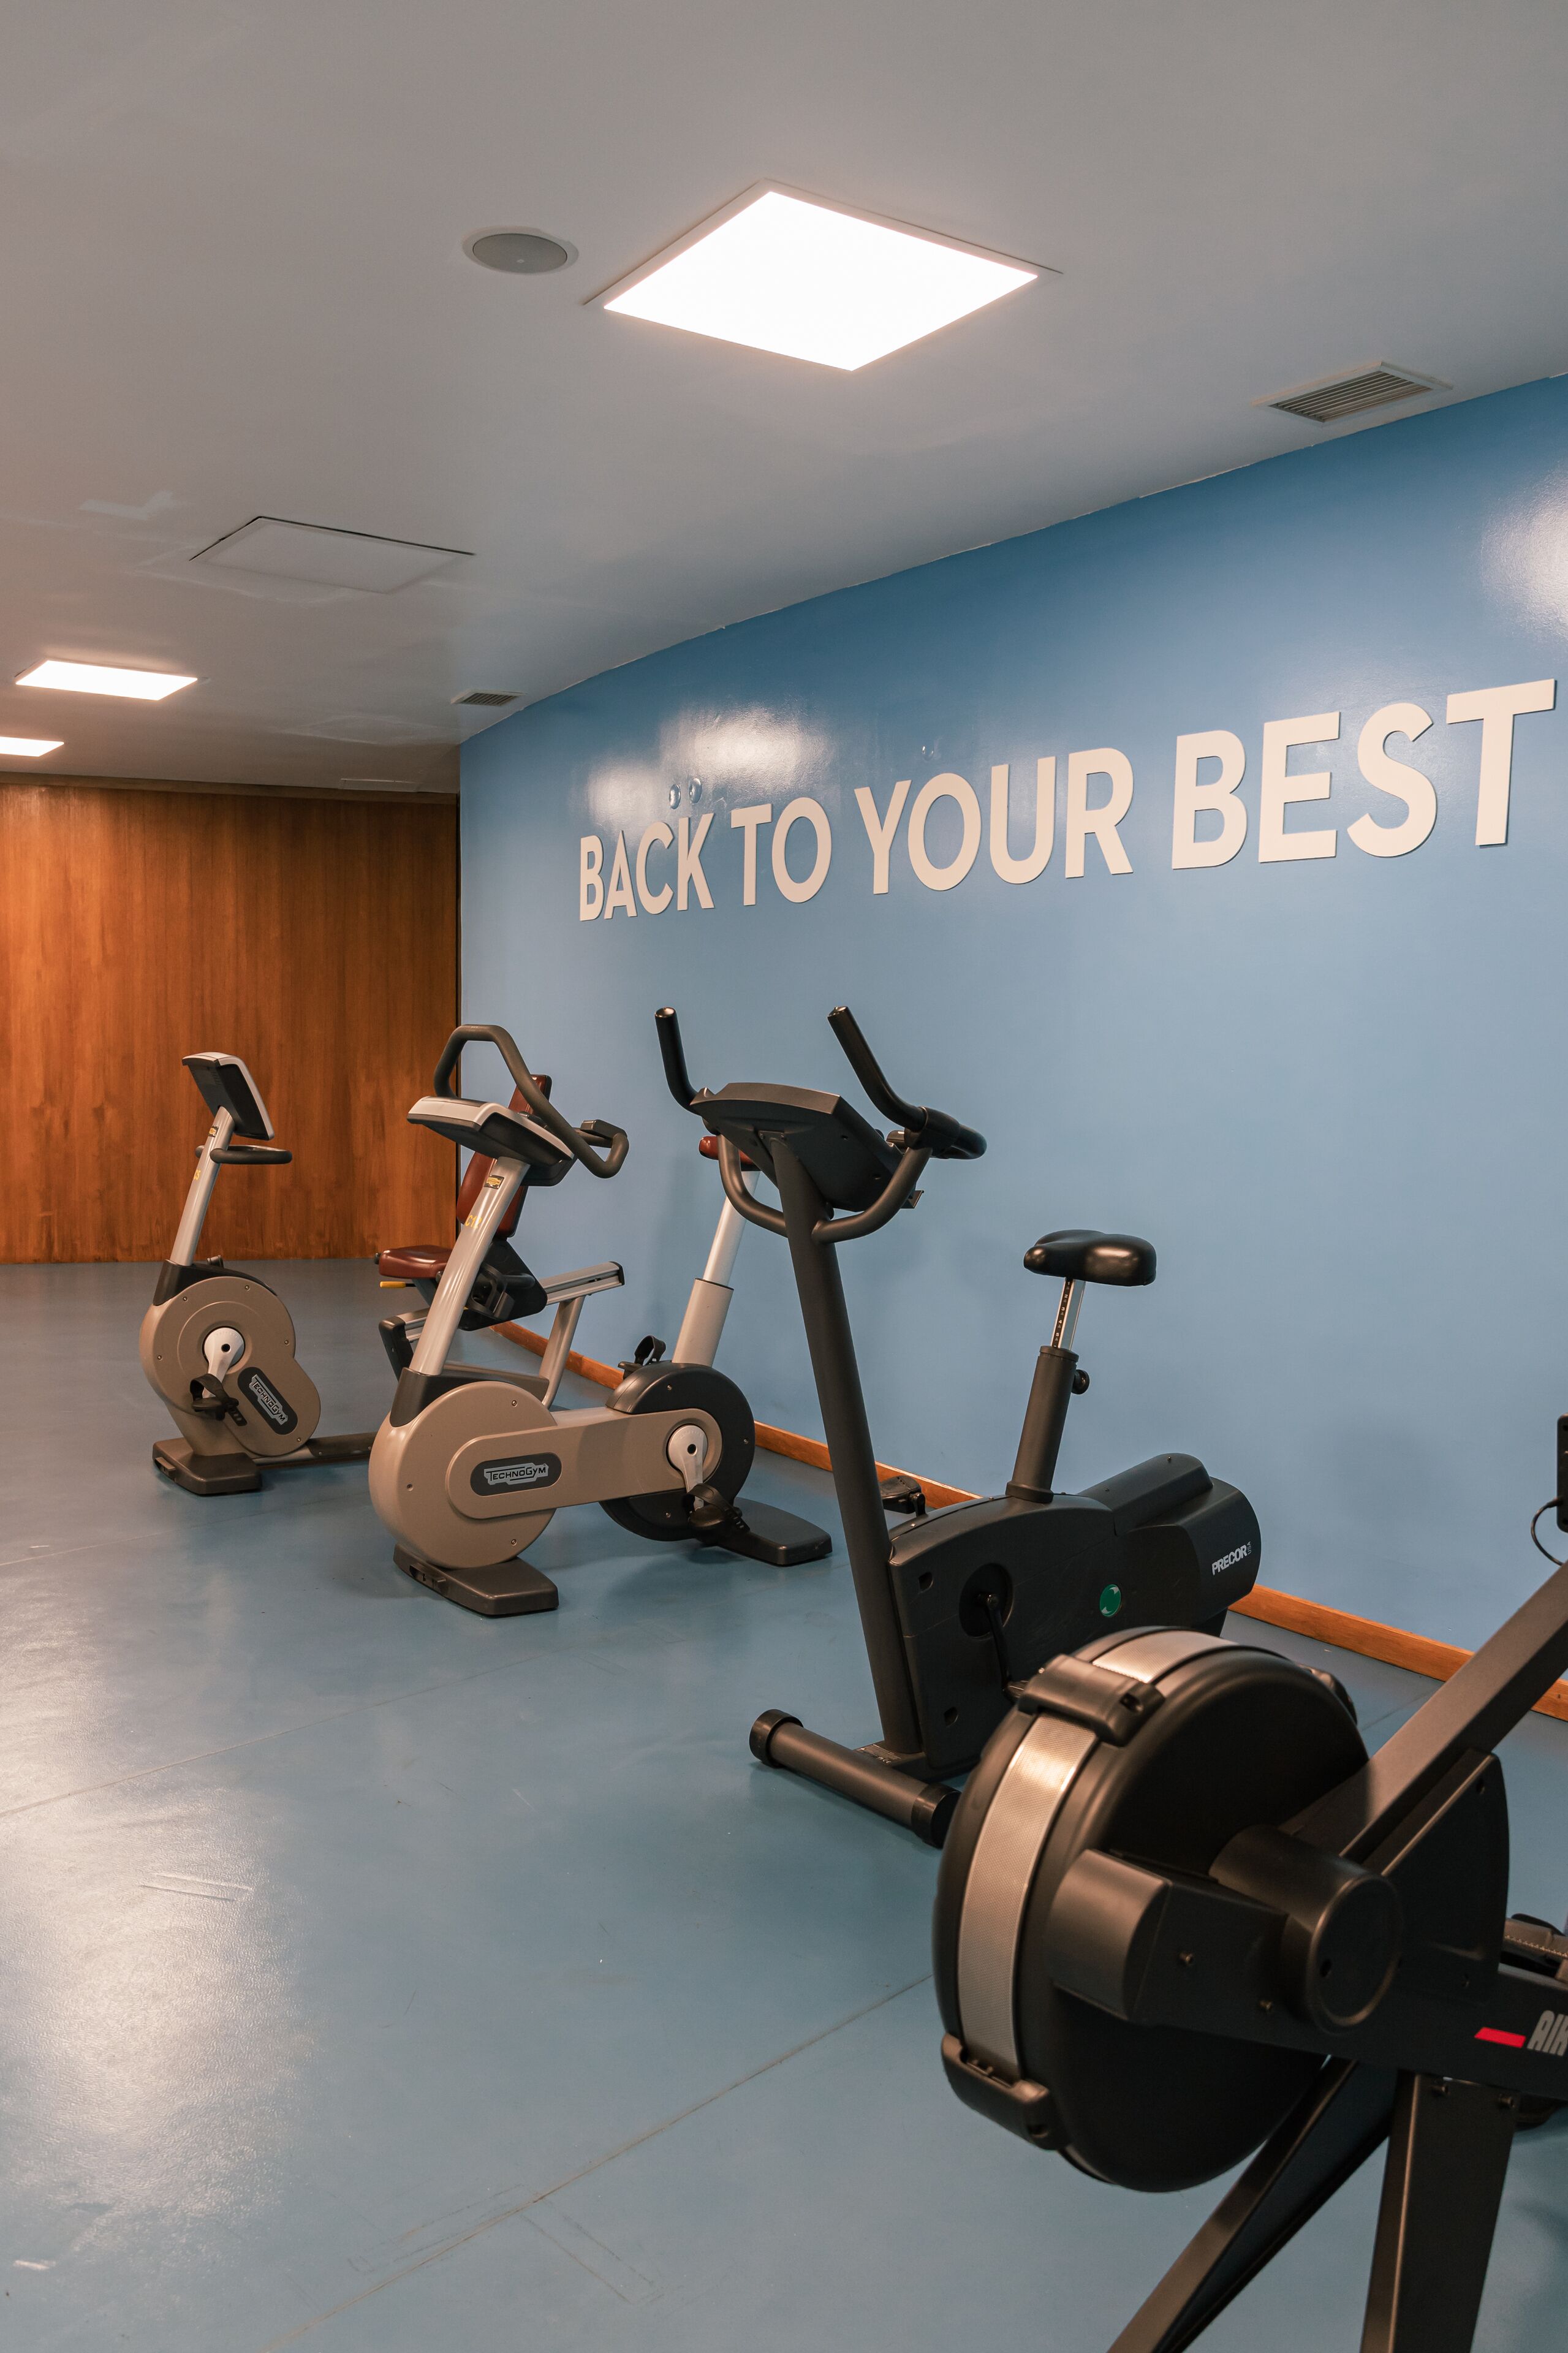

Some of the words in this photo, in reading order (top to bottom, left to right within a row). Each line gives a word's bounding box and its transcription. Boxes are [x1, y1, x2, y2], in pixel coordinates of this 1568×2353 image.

[580, 813, 715, 922] BACK
[731, 797, 832, 906] TO
[854, 747, 1134, 894] YOUR
[1171, 678, 1556, 870] BEST
[251, 1377, 286, 1422] TECHNOGYM
[485, 1466, 547, 1482] TECHNOGYM
[1211, 1544, 1248, 1575] PRECOR
